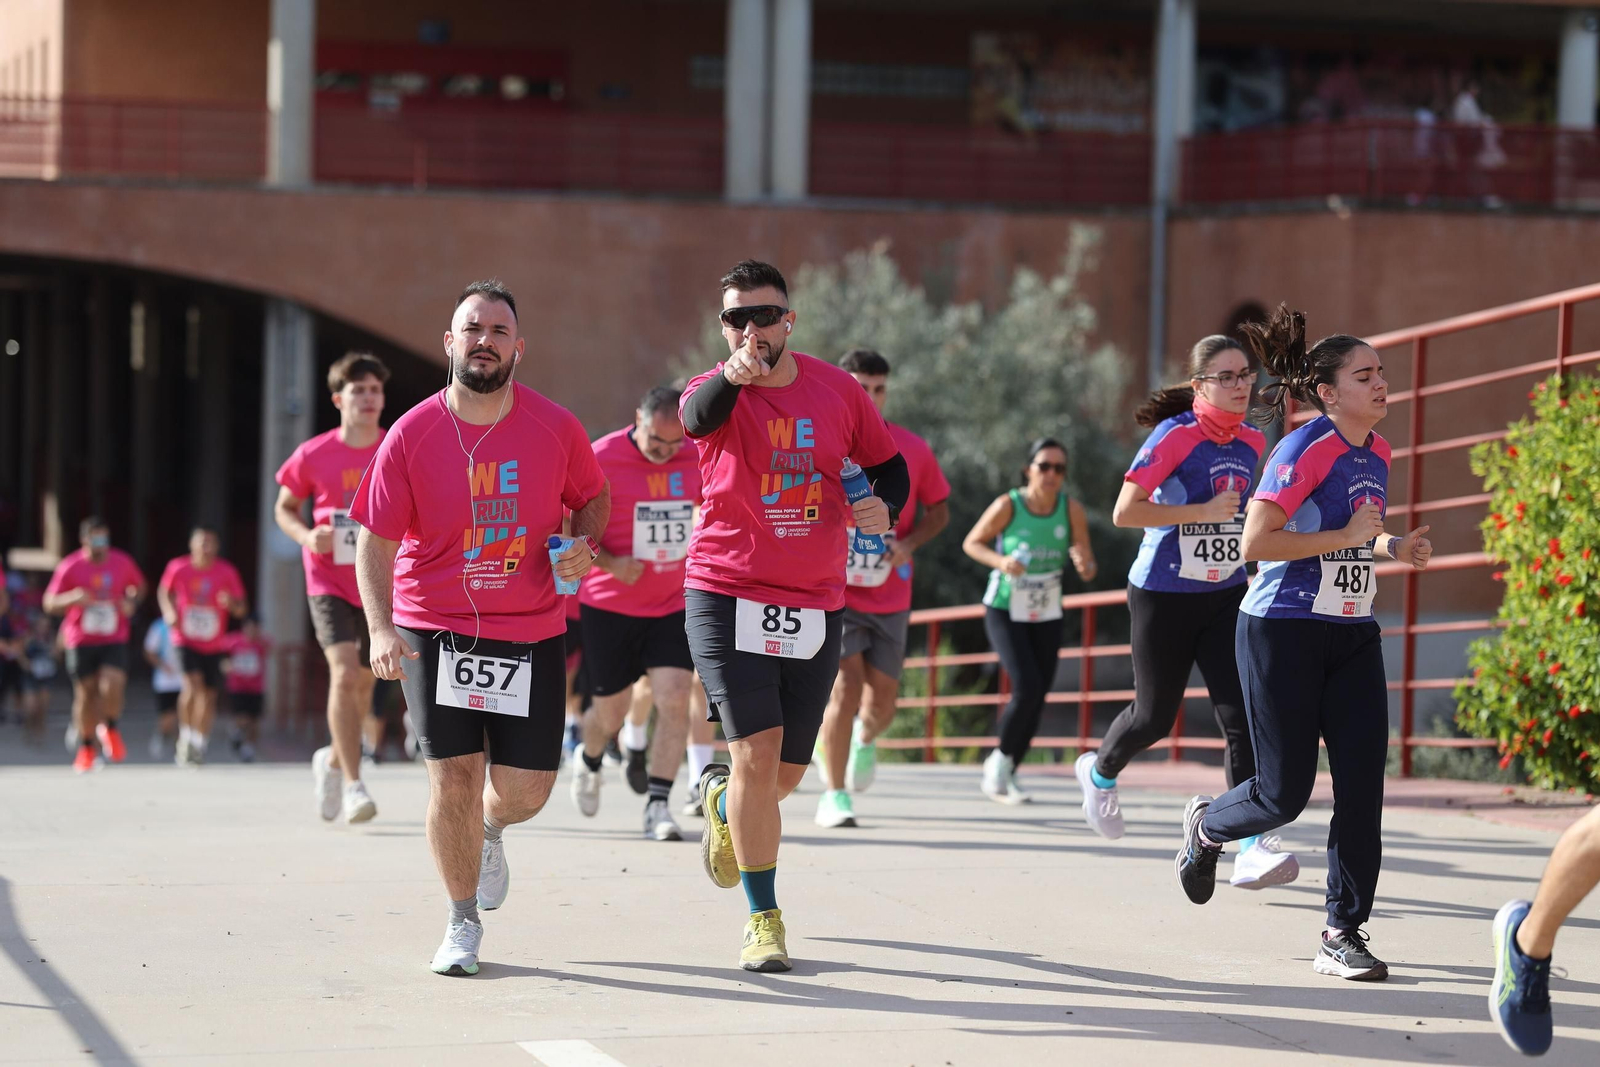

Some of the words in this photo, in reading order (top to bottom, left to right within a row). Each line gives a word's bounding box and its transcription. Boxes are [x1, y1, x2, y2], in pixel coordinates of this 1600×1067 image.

[767, 417, 815, 449] WE
[774, 452, 813, 472] RUN
[466, 460, 519, 497] WE
[647, 472, 685, 498] WE
[761, 473, 823, 504] UMA
[477, 500, 516, 522] RUN
[646, 523, 686, 544] 113
[1183, 525, 1217, 535] UMA
[463, 526, 527, 560] UMA
[1193, 538, 1240, 562] 488
[1325, 549, 1355, 560] UMA
[1334, 565, 1371, 594] 487
[762, 604, 801, 635] 85
[1344, 604, 1355, 612] WE
[766, 642, 780, 652] WE
[455, 657, 519, 690] 657
[469, 697, 485, 706] WE
